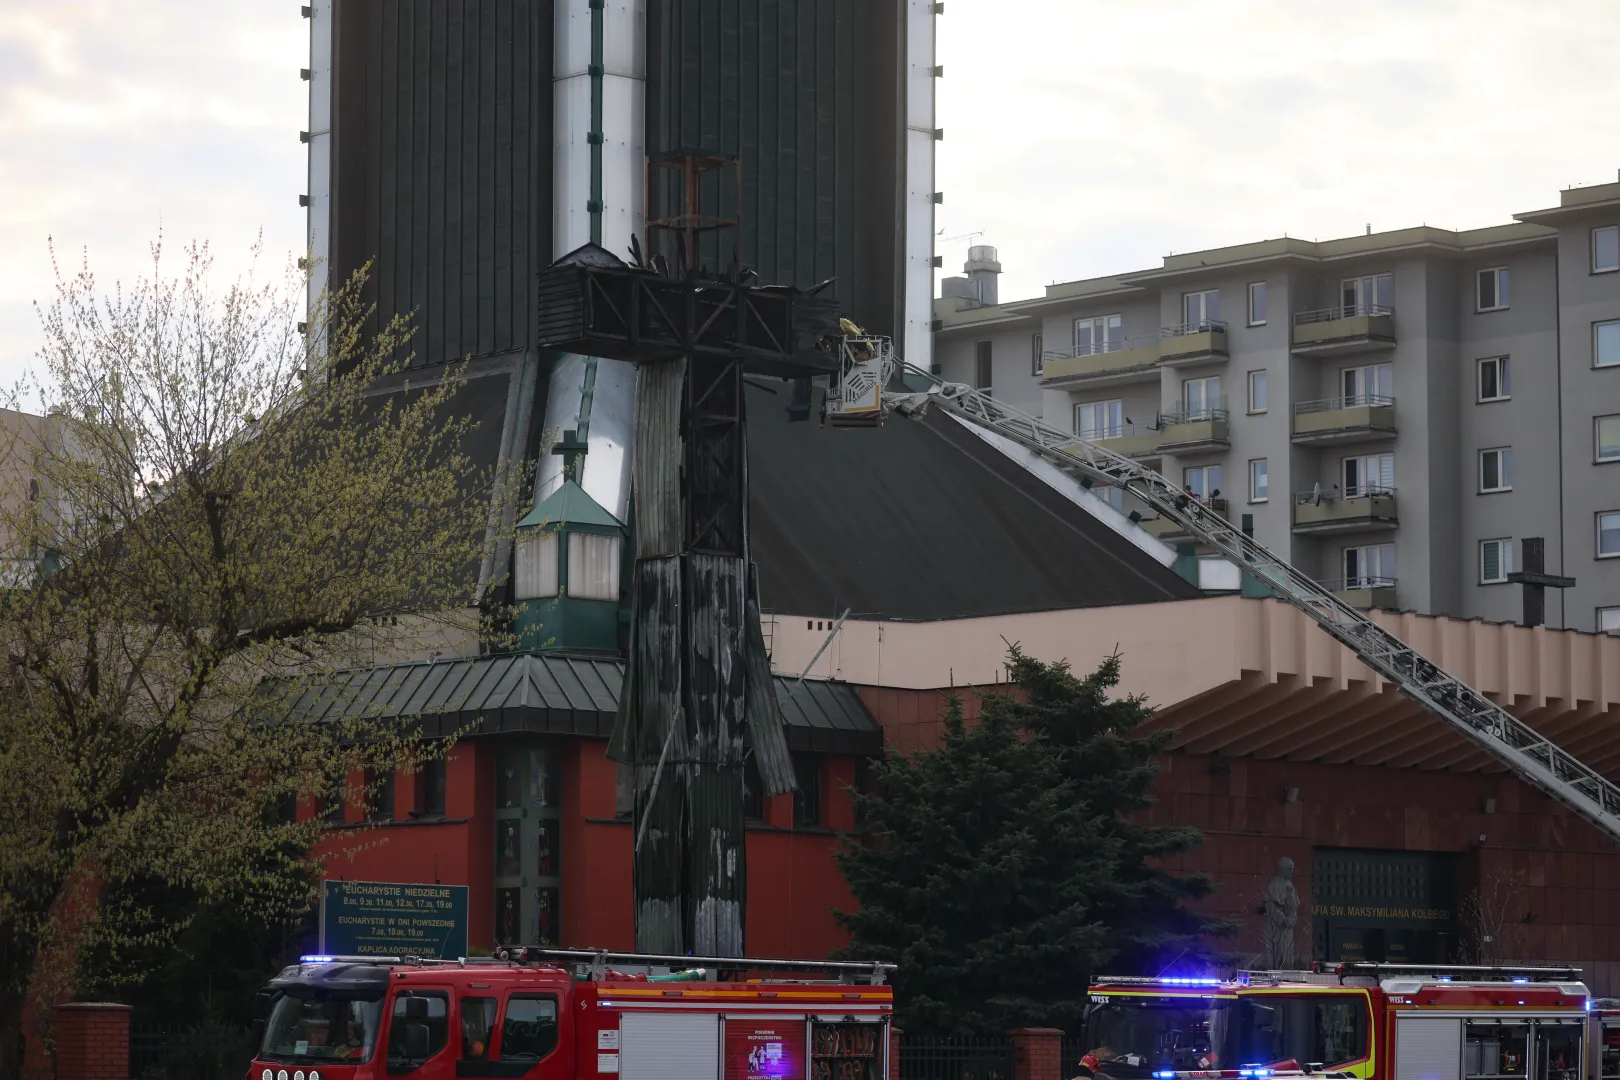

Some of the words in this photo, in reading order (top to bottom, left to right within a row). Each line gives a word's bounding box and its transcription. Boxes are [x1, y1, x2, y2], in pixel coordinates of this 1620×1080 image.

[852, 380, 877, 404] MAGIRUS
[346, 886, 401, 896] EUCHARYSTIE
[405, 888, 450, 897] NIEDZIELNE
[436, 900, 452, 909] 19.00
[1331, 903, 1346, 916] ŚW.
[1347, 906, 1410, 918] MAKSYMILIANA
[1411, 908, 1450, 920] KOLBEGO
[338, 916, 385, 925] EUCHARYSTIE
[398, 918, 410, 926] DNI
[413, 919, 455, 927] POWSZEDNIE
[408, 928, 424, 937] 19.00
[357, 945, 388, 954] KAPLICA
[389, 946, 435, 955] ADORACYJNA
[1091, 995, 1110, 1004] WISS
[1388, 996, 1405, 1004] WISS
